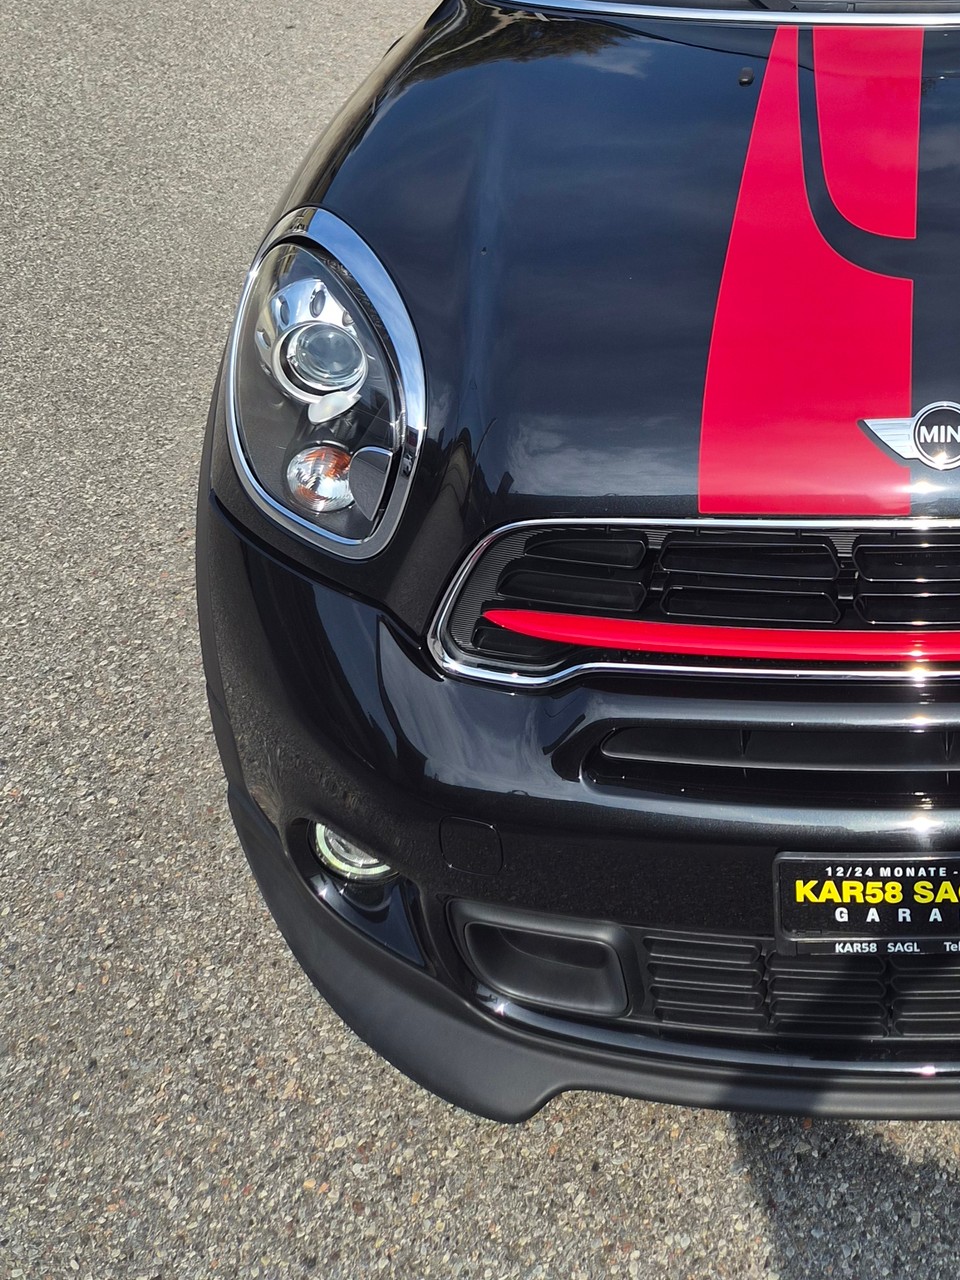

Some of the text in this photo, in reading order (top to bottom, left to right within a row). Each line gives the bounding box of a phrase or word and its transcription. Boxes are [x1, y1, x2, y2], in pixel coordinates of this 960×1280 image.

[825, 866, 873, 878] 12/24
[879, 866, 948, 878] MONATE
[795, 880, 904, 904] KAR58
[835, 942, 878, 954] KAR58
[887, 942, 921, 953] SAGL
